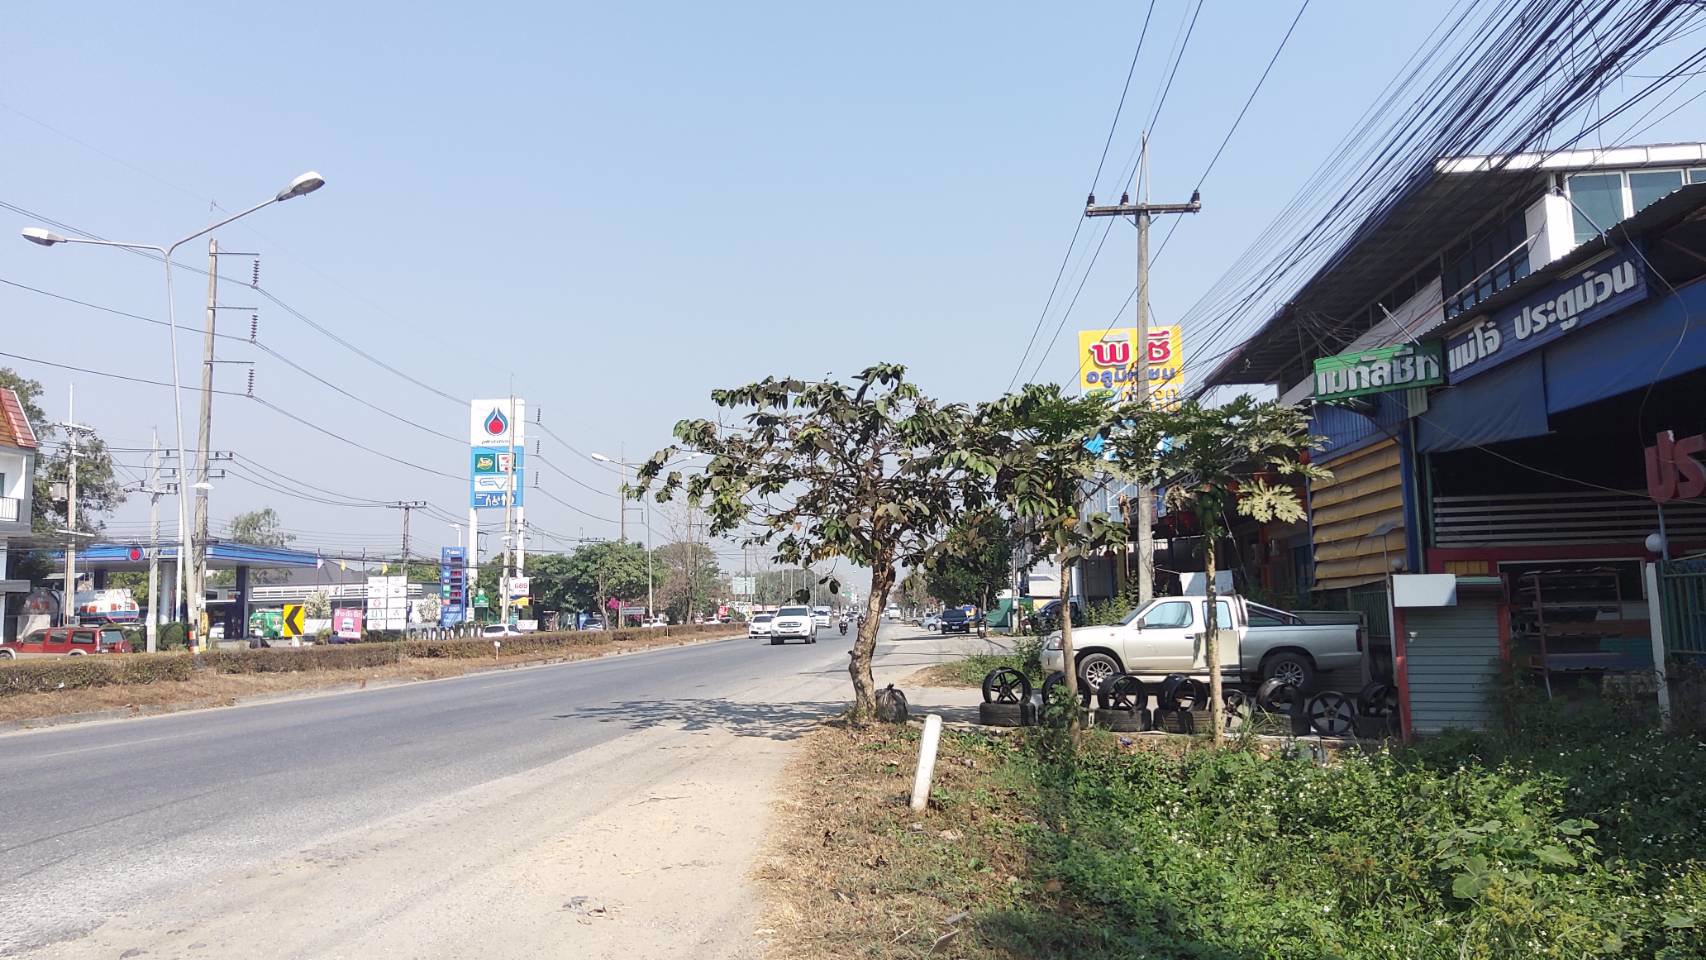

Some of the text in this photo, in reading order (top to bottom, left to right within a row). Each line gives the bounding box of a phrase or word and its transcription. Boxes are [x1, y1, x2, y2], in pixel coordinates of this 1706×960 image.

[1449, 260, 1636, 372] แม่โจ้ ประตูม้วน
[1318, 347, 1440, 395] เมทัลชีท
